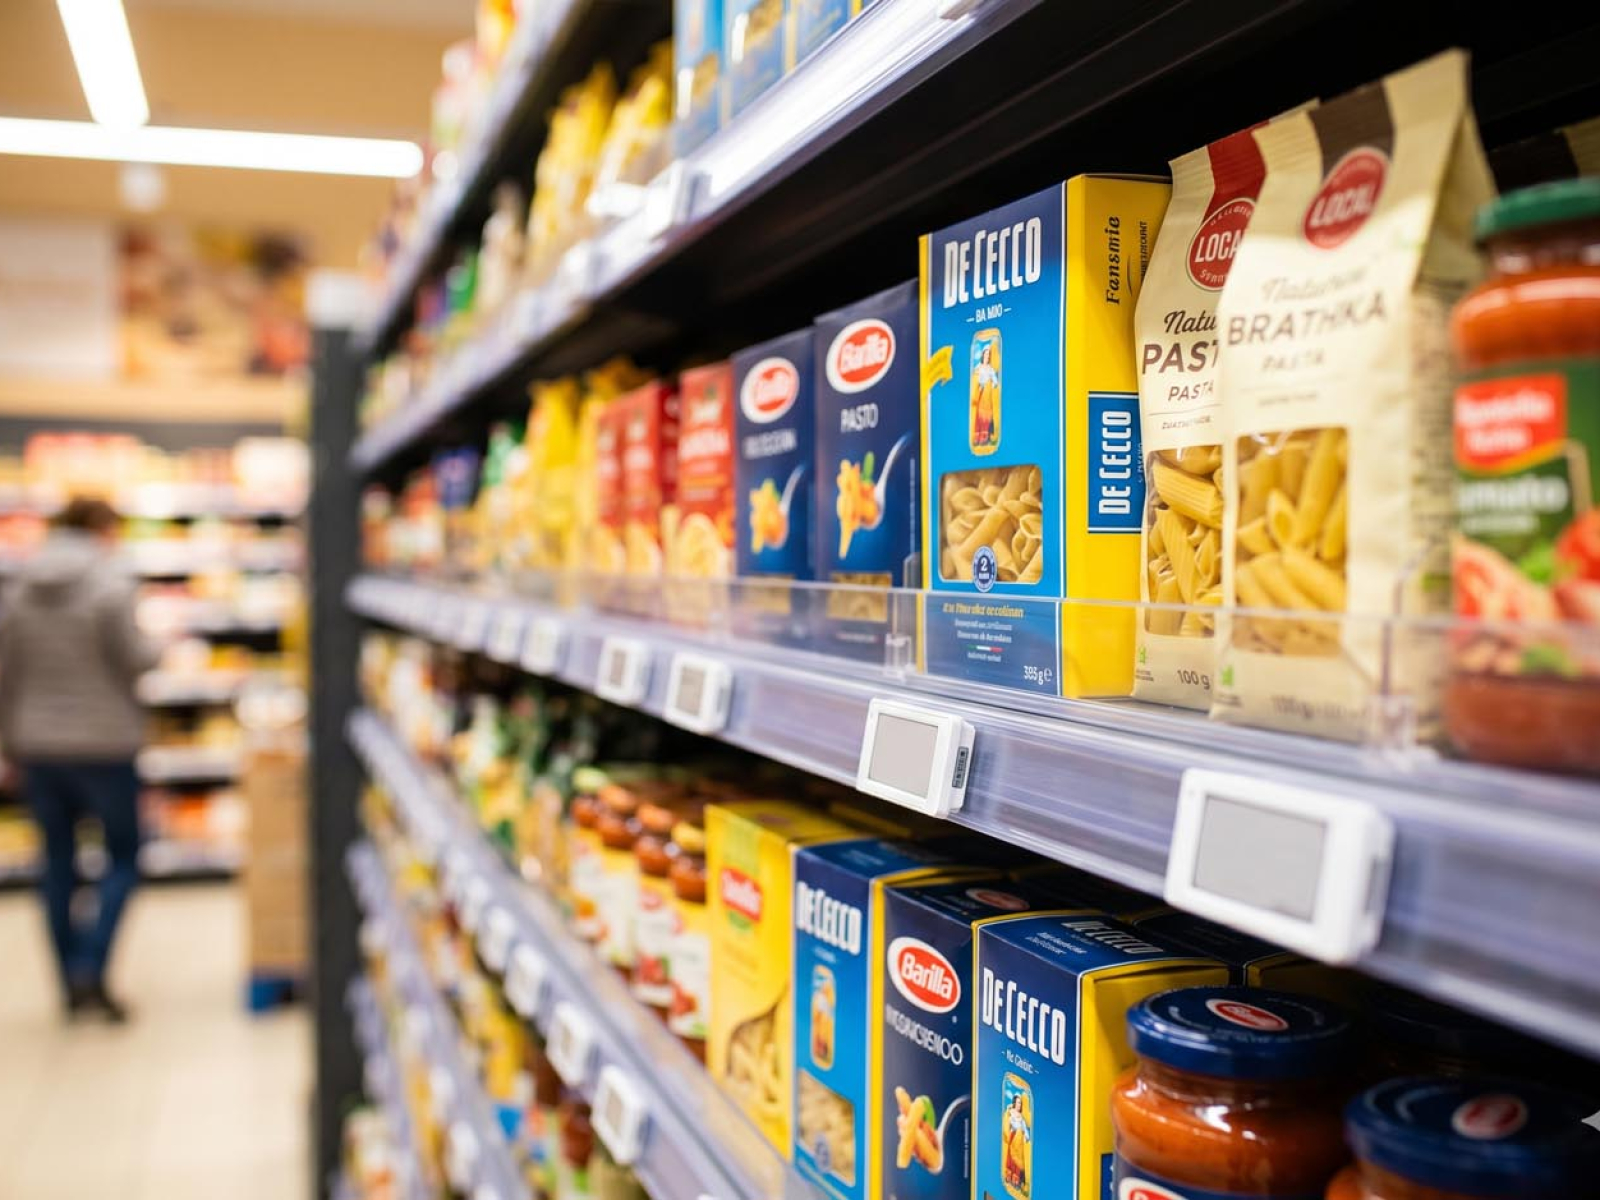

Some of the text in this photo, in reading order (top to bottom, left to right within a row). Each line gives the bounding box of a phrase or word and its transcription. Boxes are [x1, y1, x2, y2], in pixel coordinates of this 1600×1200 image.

[1309, 184, 1378, 227] LOCAL
[943, 216, 1042, 309] DE CECCO
[1194, 229, 1242, 263] LOCA
[1163, 309, 1217, 335] Natu
[1142, 339, 1219, 375] PAST
[1098, 410, 1132, 515] DE CECCO
[1177, 669, 1210, 690] 100 g
[814, 888, 863, 956] CECCO
[902, 952, 954, 1000] Barilla
[982, 966, 1067, 1067] DE CECCO
